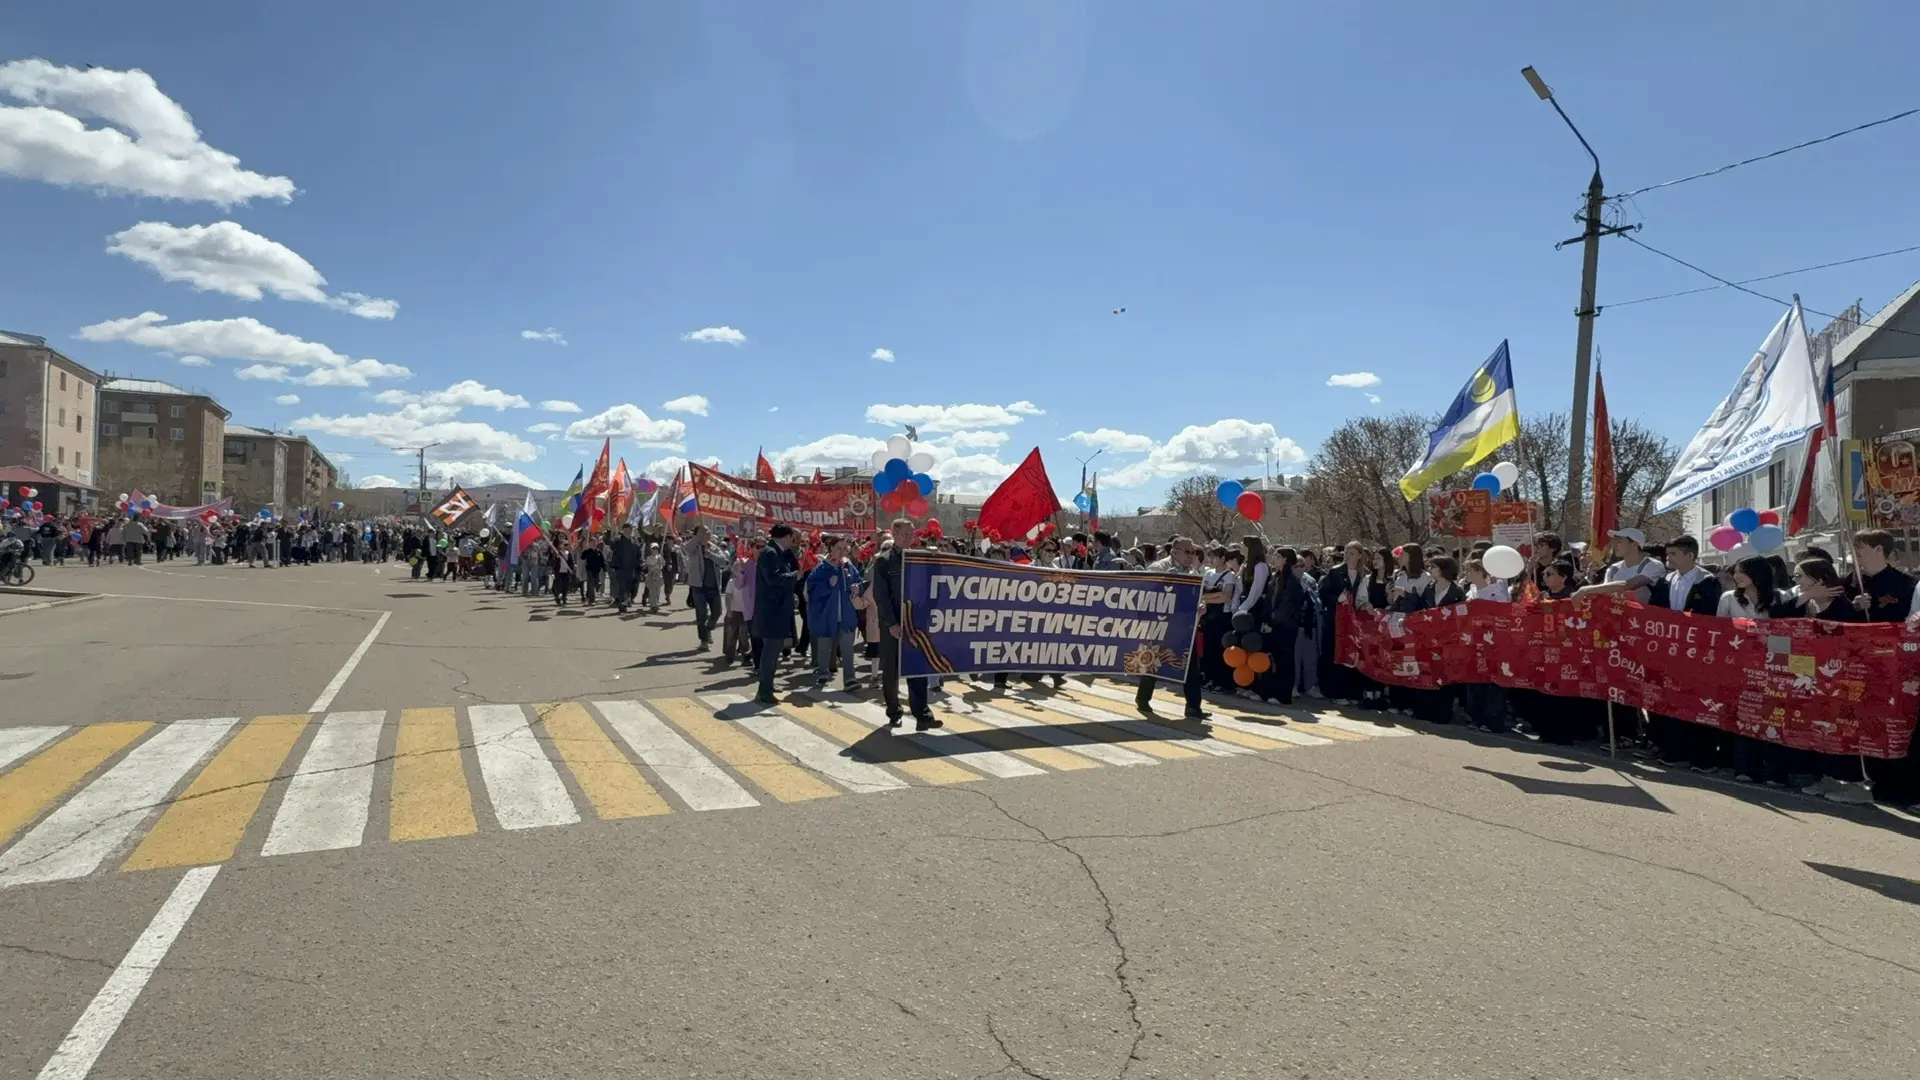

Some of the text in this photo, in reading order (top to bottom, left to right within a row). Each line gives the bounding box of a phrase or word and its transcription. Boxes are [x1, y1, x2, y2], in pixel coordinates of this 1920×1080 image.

[770, 504, 845, 526] Победы!
[929, 574, 1177, 615] ГУСИНООЗЕРСКИЙ
[928, 608, 1169, 641] ЭНЕРГЕТИЧЕСКИЙ
[1644, 620, 1664, 638] 80
[969, 641, 1118, 667] ТЕХНИКУМ
